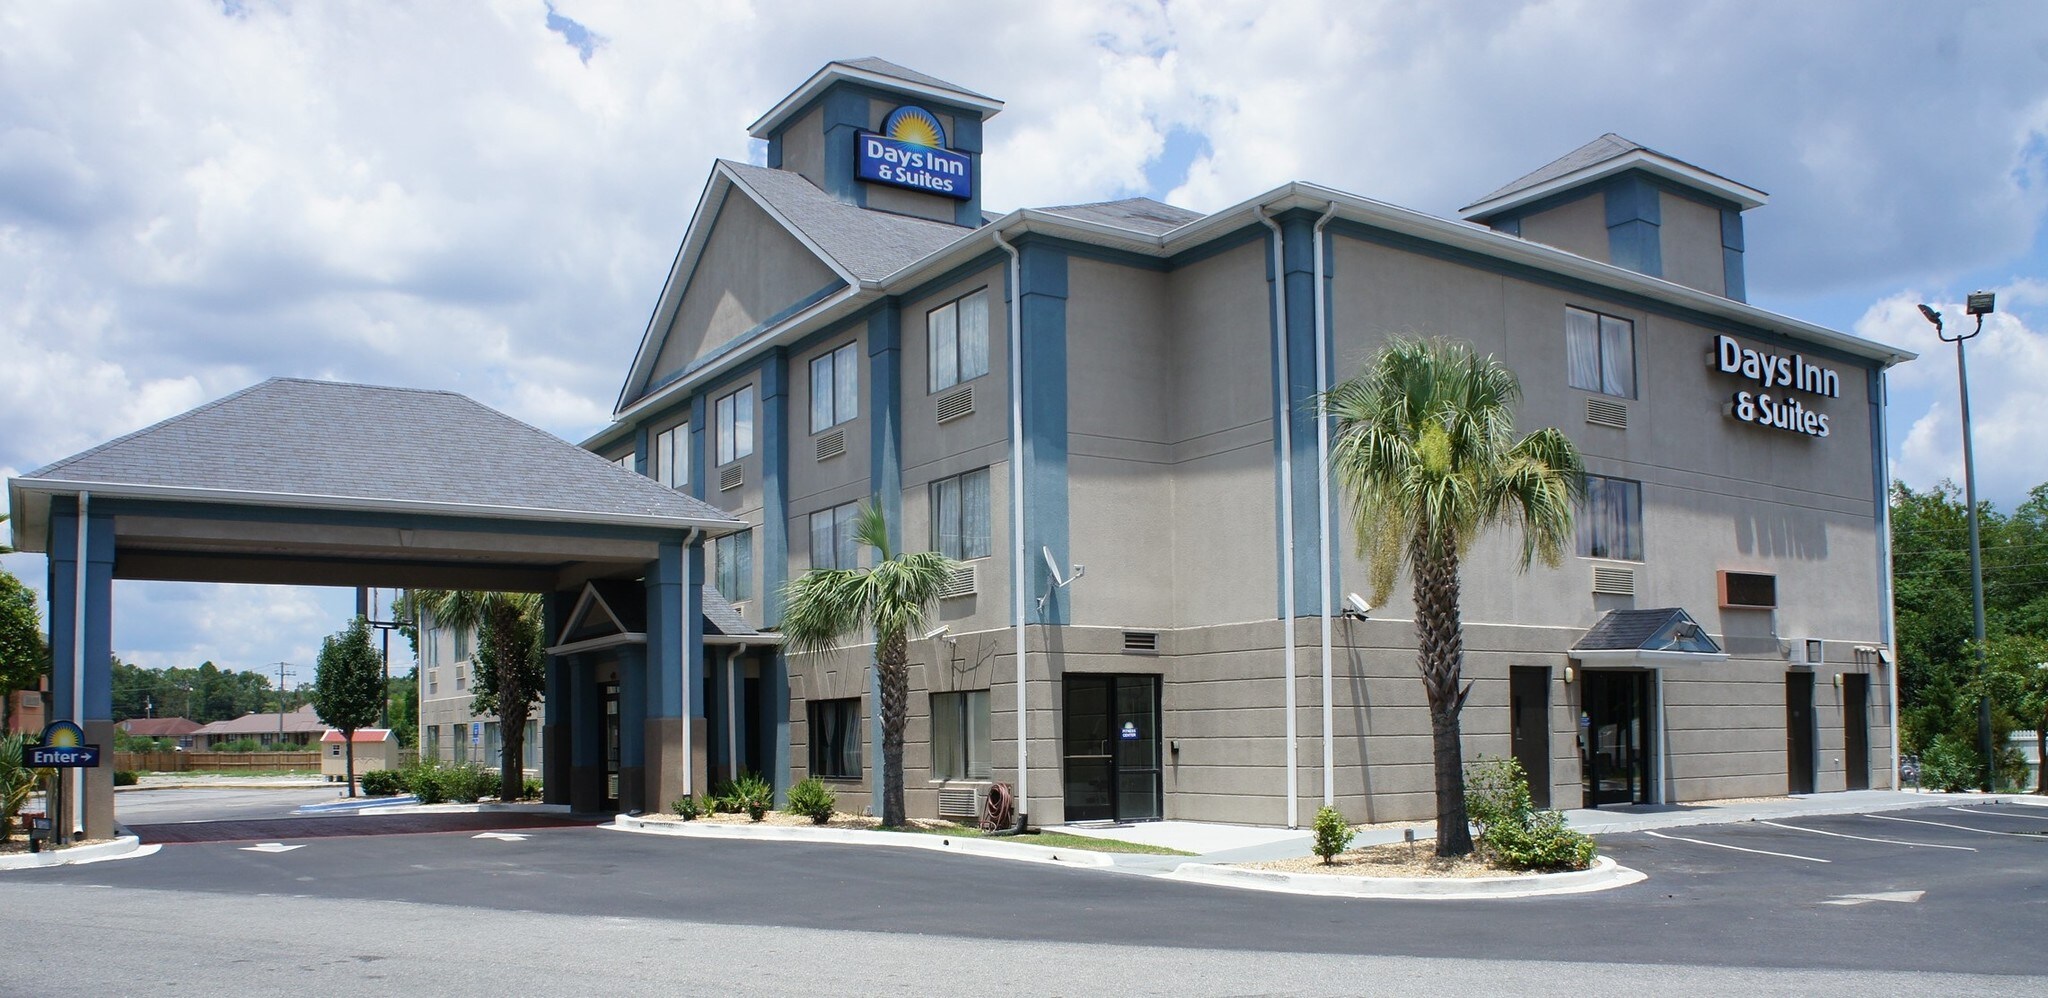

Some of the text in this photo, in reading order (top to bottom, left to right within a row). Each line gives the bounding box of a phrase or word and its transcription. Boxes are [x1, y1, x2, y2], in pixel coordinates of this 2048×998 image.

[867, 139, 964, 176] Days Inn
[878, 164, 954, 192] & Suites
[1717, 334, 1840, 398] Days Inn
[1735, 390, 1830, 438] & Suites
[33, 751, 79, 763] Enter
